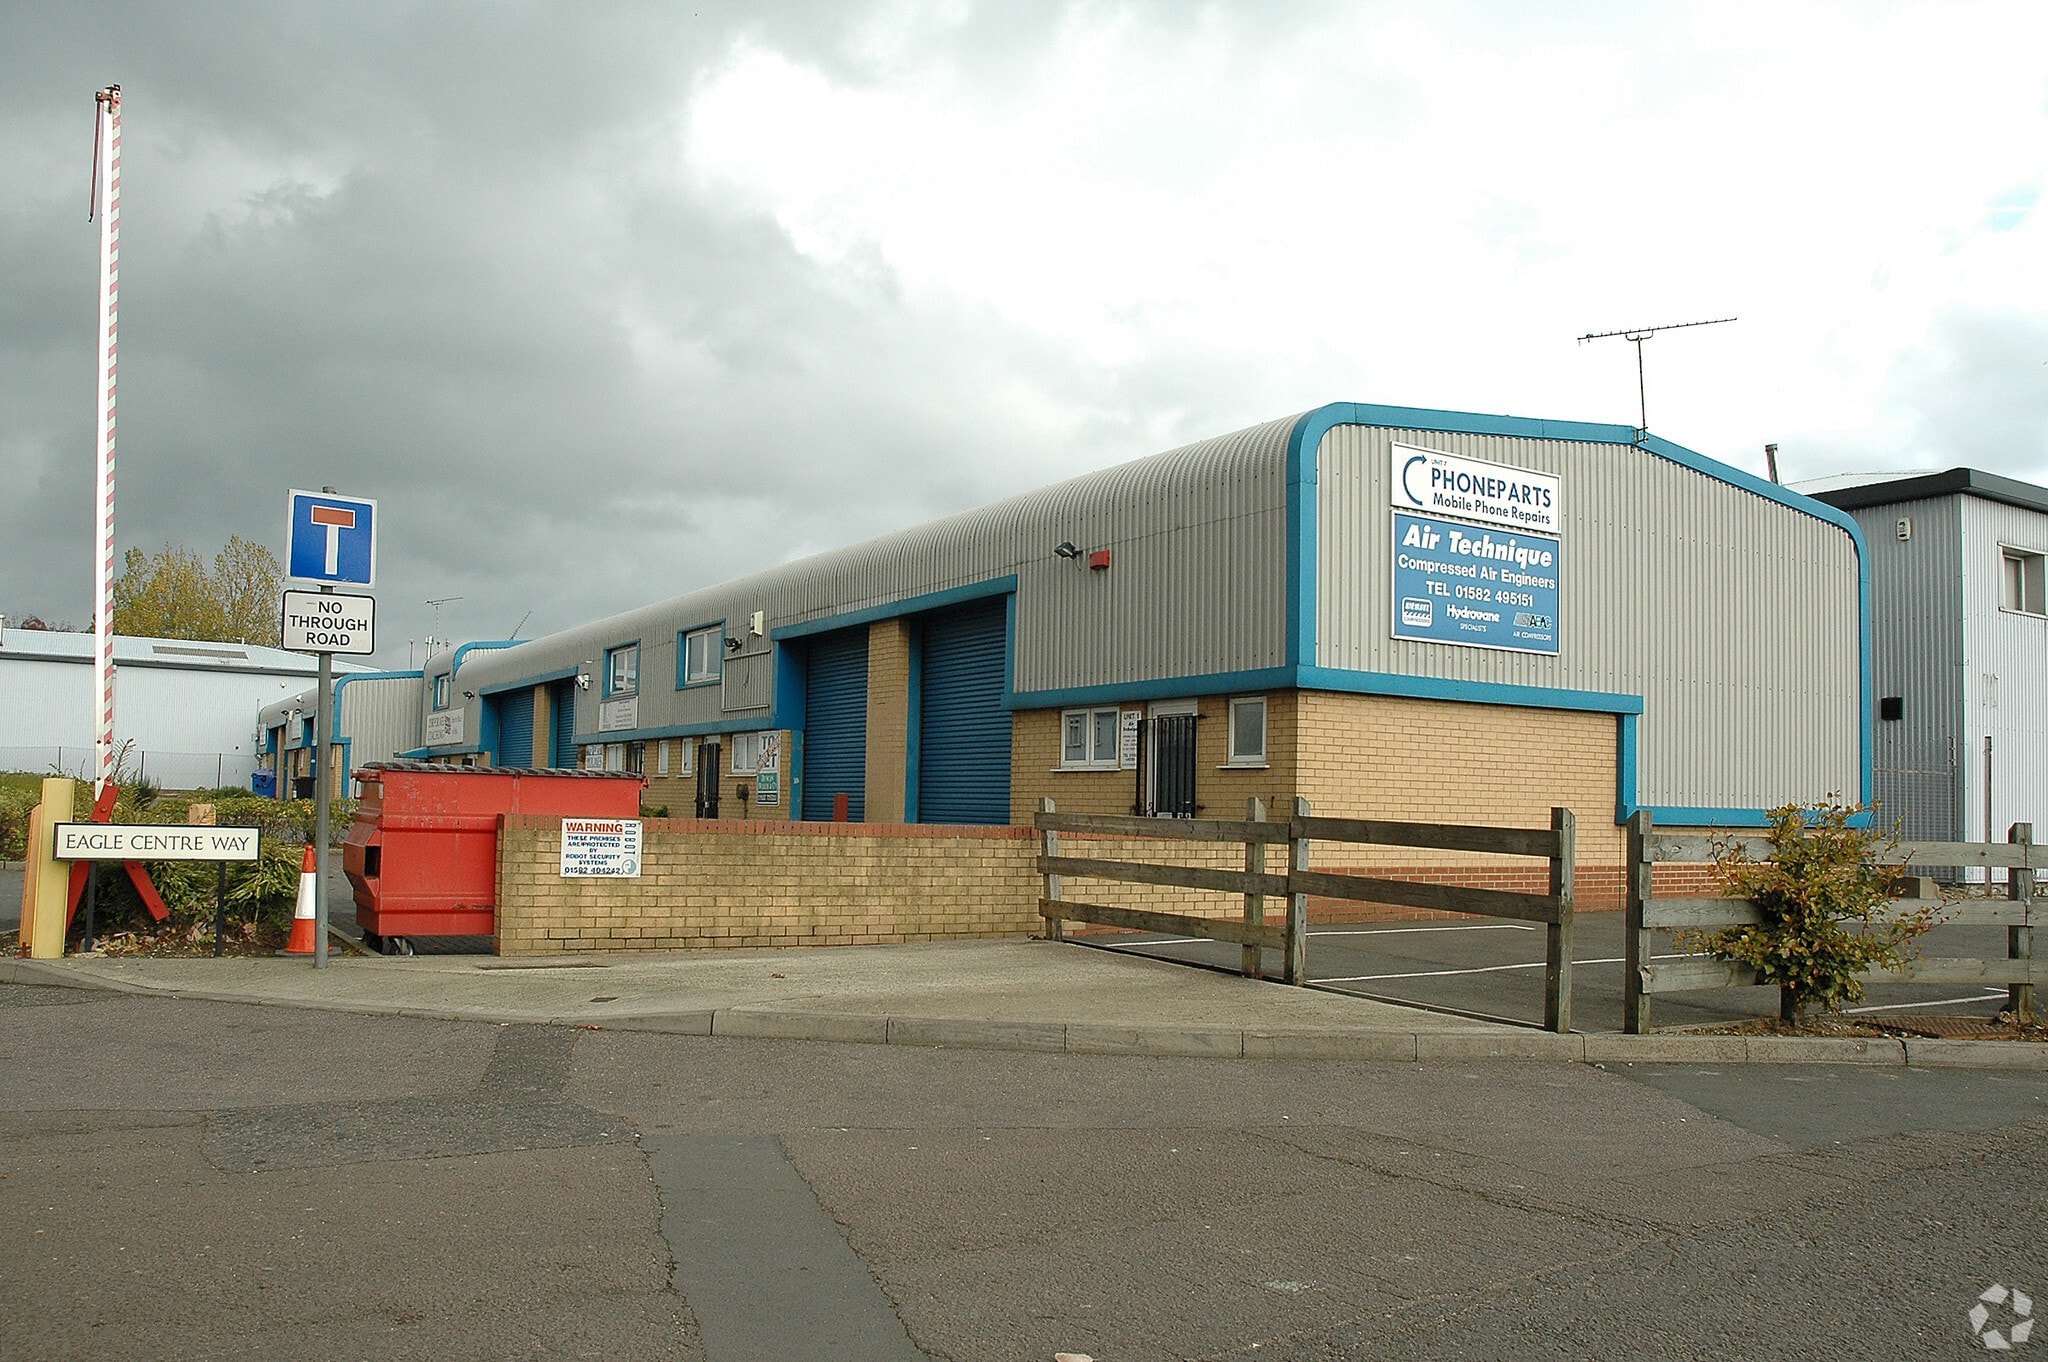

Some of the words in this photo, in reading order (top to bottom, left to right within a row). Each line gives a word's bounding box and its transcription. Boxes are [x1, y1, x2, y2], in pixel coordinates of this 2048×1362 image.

[1431, 467, 1551, 508] PHONEPARTS
[1433, 492, 1472, 511] Mobile
[1475, 499, 1509, 518] Phone
[1511, 506, 1551, 525] Repairs
[1402, 524, 1441, 550] Air
[1449, 530, 1553, 570] Technique
[1398, 554, 1476, 578] Compressed
[1480, 566, 1498, 581] Air
[1501, 569, 1555, 590] Engineers
[1426, 581, 1450, 597] TEL
[1455, 585, 1491, 602] 01582
[1495, 590, 1534, 607] 495151
[318, 601, 342, 614] NO
[1446, 604, 1500, 622] Hydrovane
[289, 615, 368, 631] THROUGH
[306, 632, 350, 646] ROAD
[566, 822, 623, 832] WARNING
[66, 834, 123, 850] EAGLE
[130, 835, 204, 851] CENTRE
[211, 836, 250, 851] WAY
[624, 823, 637, 855] ROBOT
